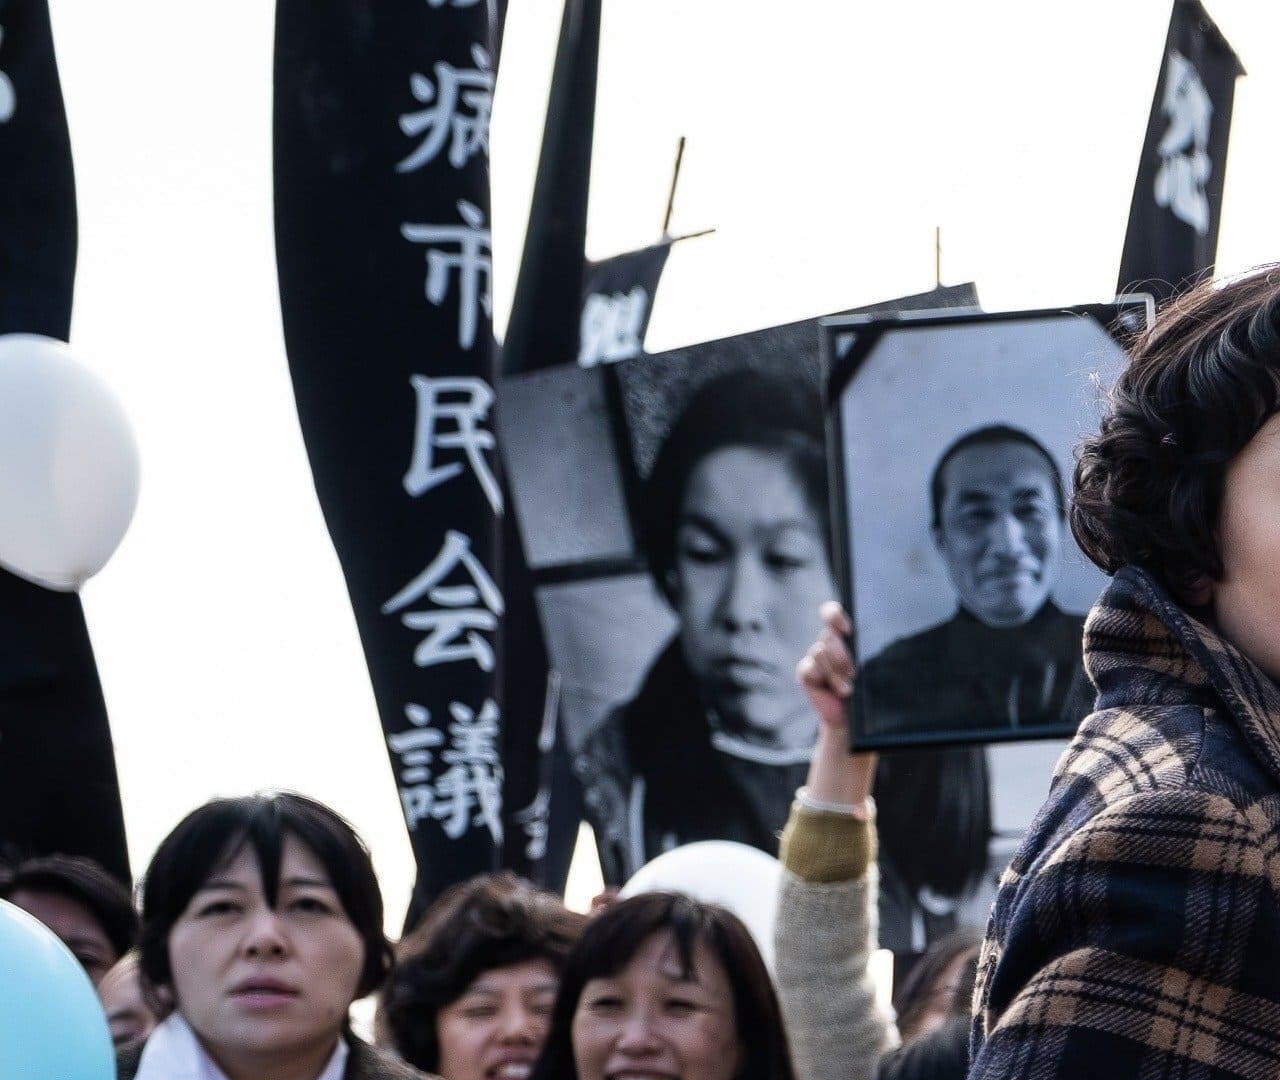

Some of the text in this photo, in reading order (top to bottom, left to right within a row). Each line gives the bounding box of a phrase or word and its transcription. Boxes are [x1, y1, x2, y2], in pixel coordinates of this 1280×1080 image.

[382, 0, 504, 848] 病市民会議
